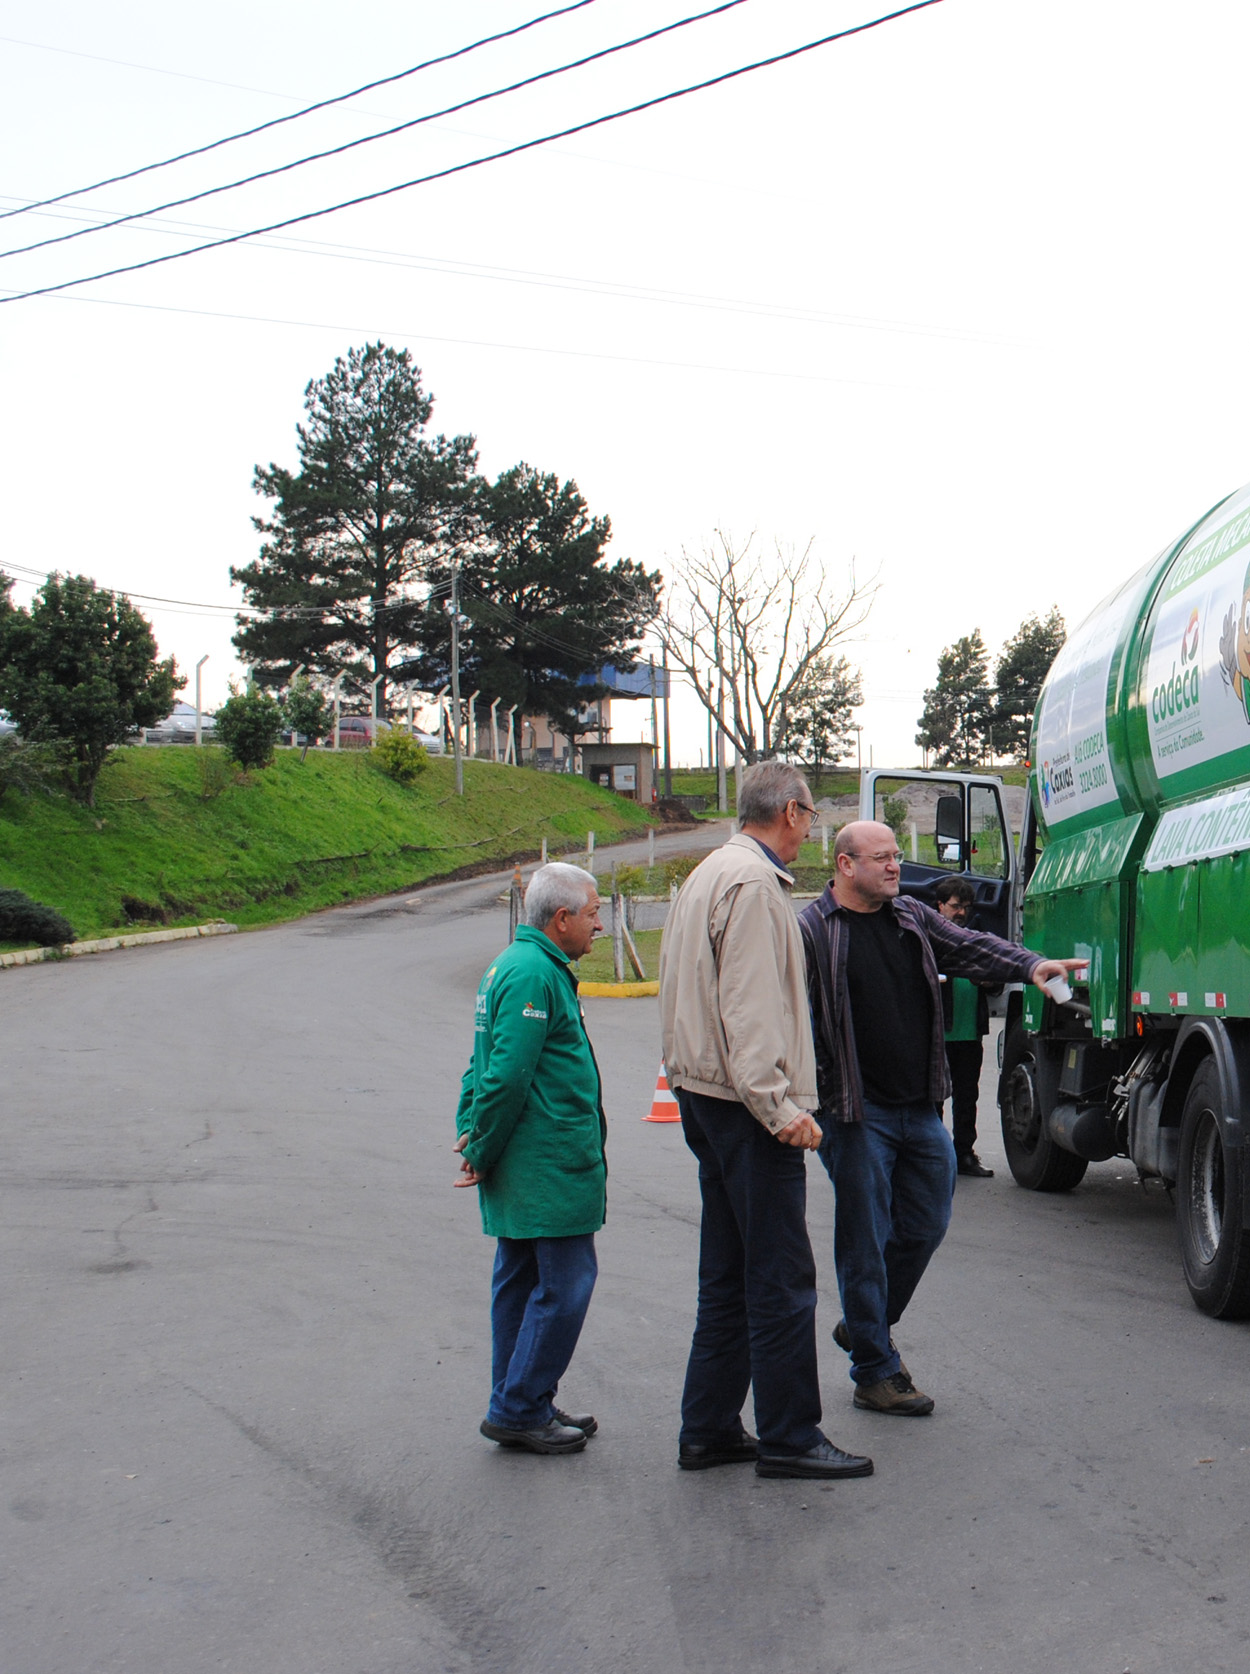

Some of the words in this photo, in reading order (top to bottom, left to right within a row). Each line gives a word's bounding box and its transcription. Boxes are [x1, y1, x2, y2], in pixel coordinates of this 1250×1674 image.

[1170, 535, 1219, 591] COLETA
[1153, 661, 1199, 724] codeca
[1083, 730, 1105, 761] CODECA
[1050, 766, 1074, 794] Caxias
[1151, 817, 1192, 864] LAVA
